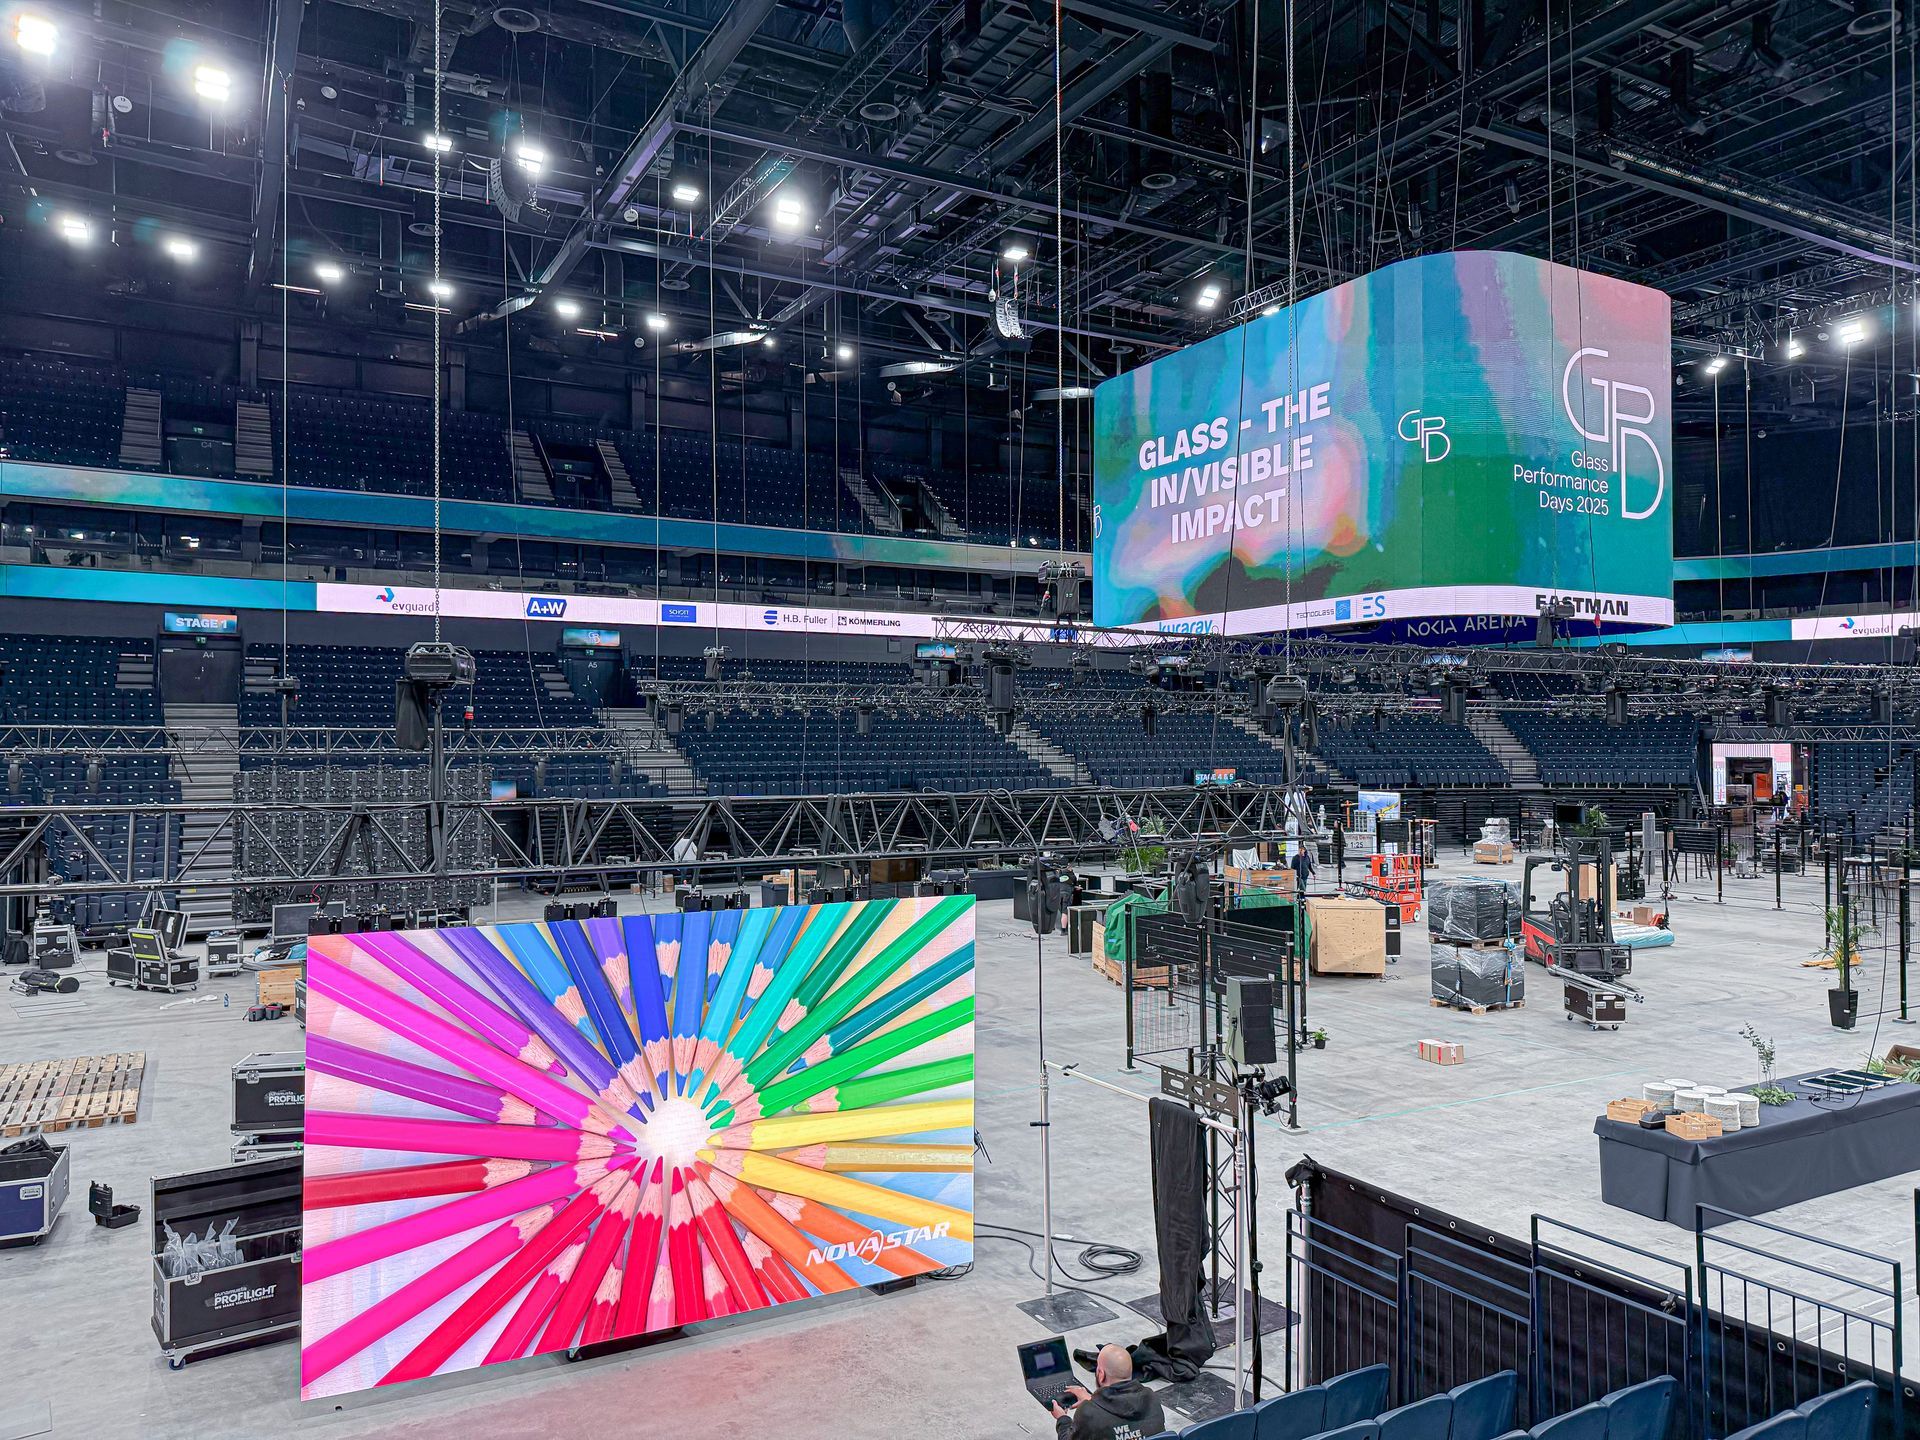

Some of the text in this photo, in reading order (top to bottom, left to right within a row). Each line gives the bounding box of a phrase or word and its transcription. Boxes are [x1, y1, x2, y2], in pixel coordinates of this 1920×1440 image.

[1139, 381, 1331, 471] GLASS - THE
[1571, 451, 1609, 472] Glass
[1151, 434, 1313, 509] IN/VISIBLE
[1513, 464, 1609, 494] Performance
[1539, 490, 1609, 516] Days 2025
[1171, 487, 1286, 544] IMPACT
[391, 602, 435, 613] evguard
[529, 601, 564, 615] A+W
[1362, 595, 1386, 619] ES
[175, 617, 228, 629] STAGE 1
[783, 614, 828, 625] H.B. Fuller
[849, 617, 901, 627] KÖMMERLING
[1407, 615, 1528, 638] NOKIA ARENA
[202, 650, 215, 659] A4
[587, 661, 598, 669] A5
[268, 1094, 304, 1103] PROFILIG
[214, 1284, 277, 1306] PROFILIGHT
[1113, 1424, 1130, 1435] WE
[1115, 1429, 1142, 1440] MAKE
